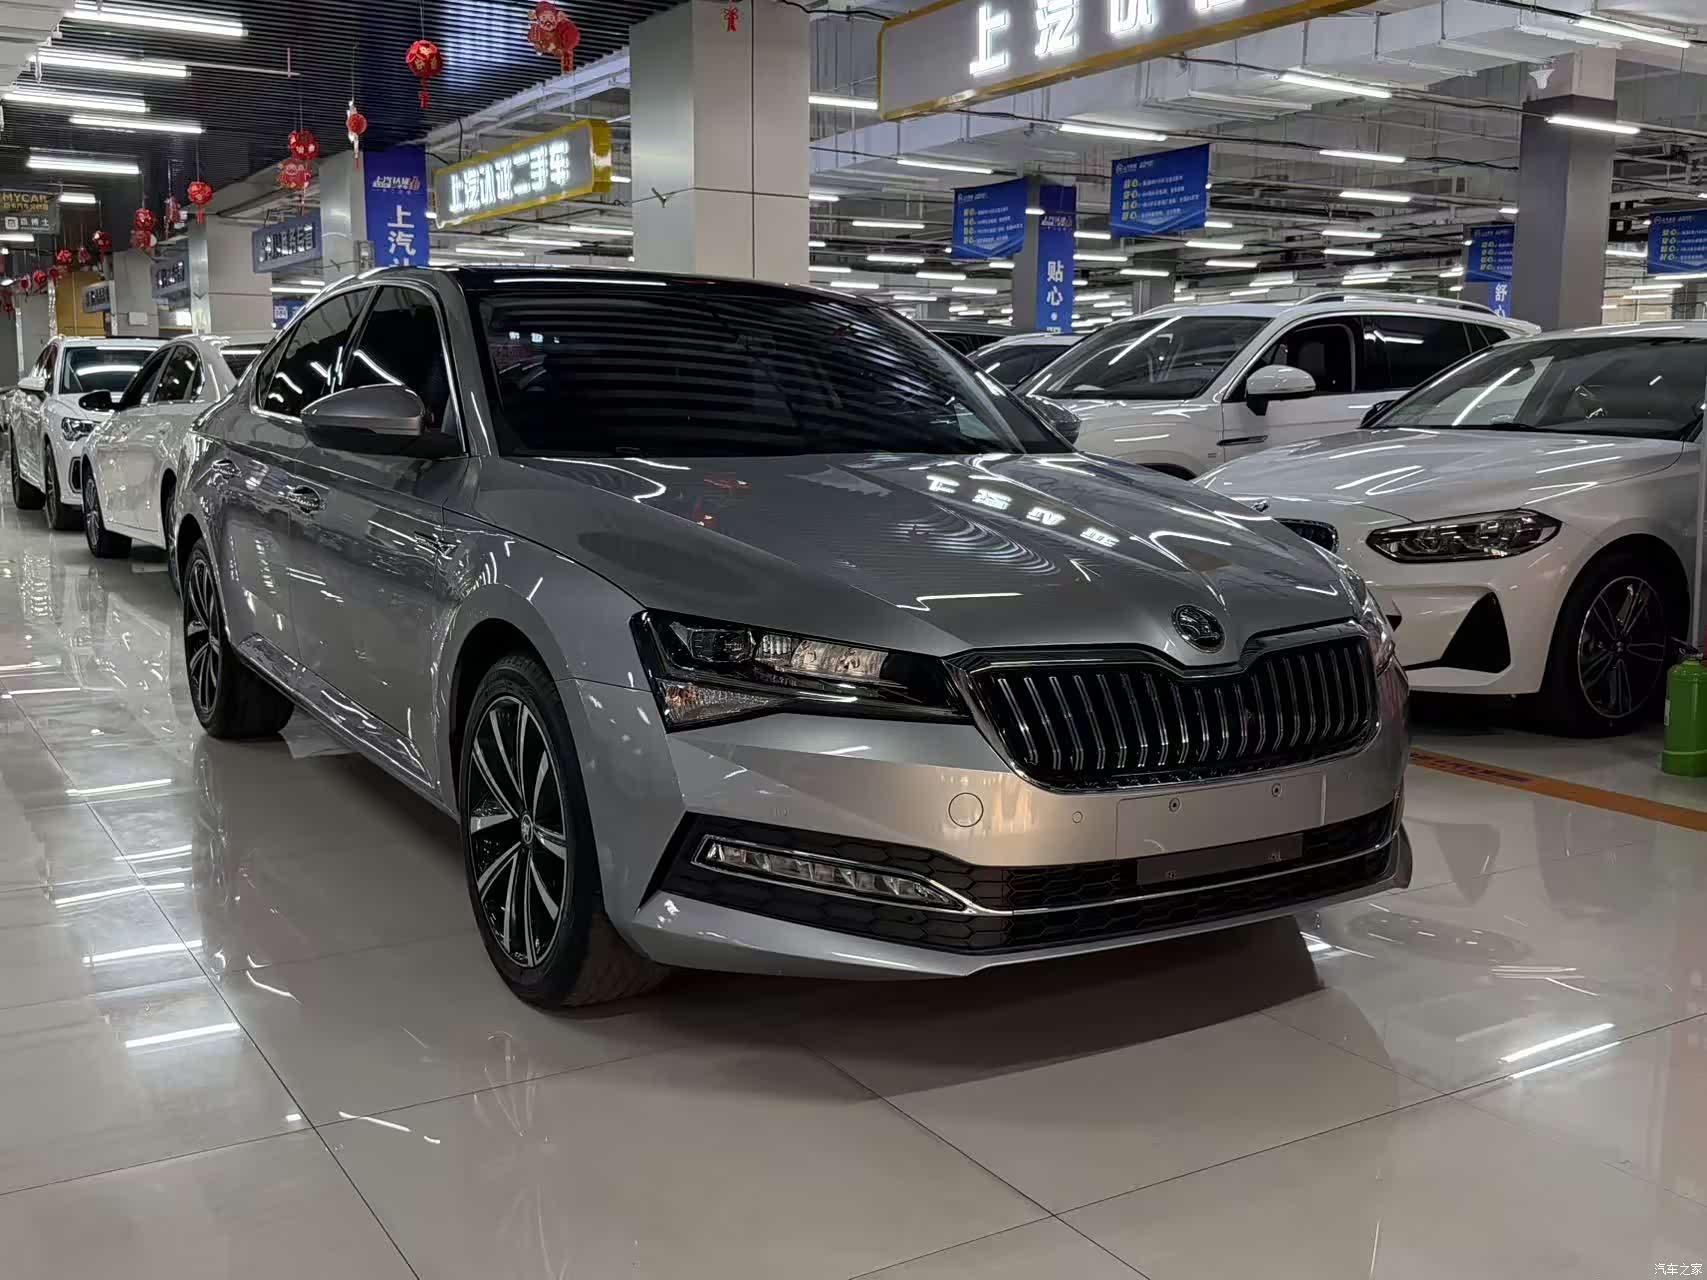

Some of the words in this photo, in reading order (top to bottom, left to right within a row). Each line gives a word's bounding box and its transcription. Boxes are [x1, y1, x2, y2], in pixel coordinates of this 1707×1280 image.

[449, 140, 571, 214] 上汽认证二手车
